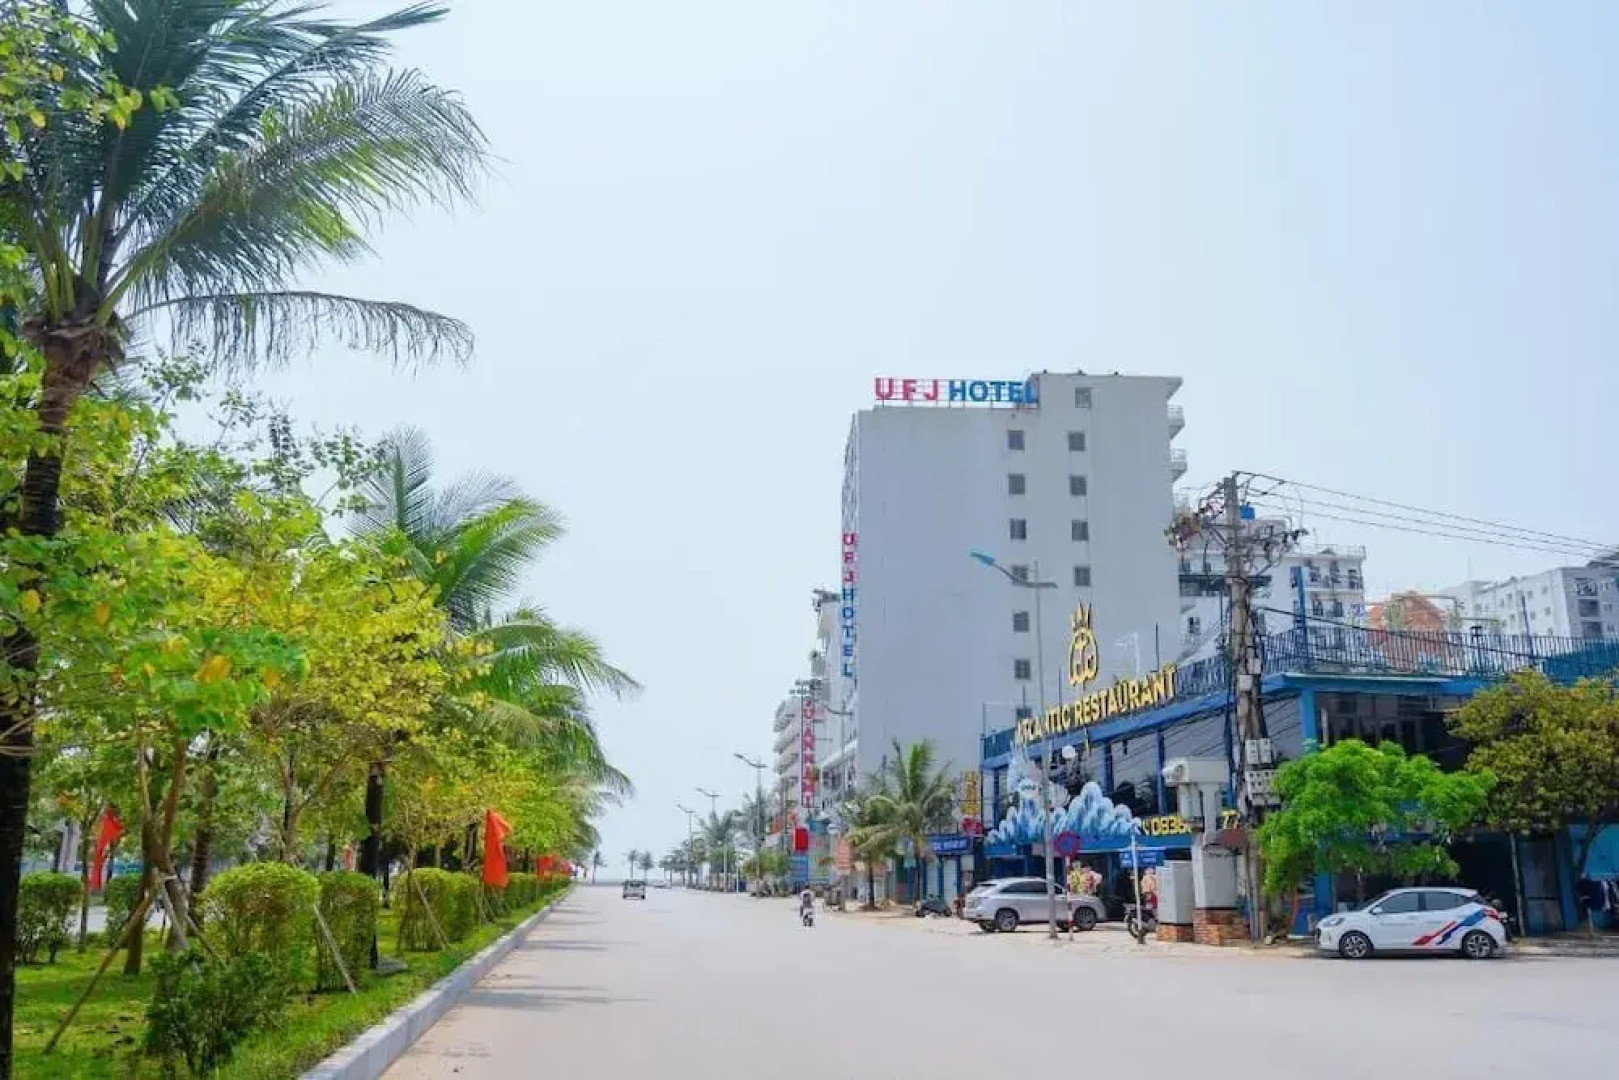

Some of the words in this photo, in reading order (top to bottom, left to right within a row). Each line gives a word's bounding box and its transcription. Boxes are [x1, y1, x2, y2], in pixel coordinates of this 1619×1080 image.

[874, 377, 938, 401] UFJ
[948, 379, 1039, 403] HOTEL
[842, 588, 855, 677] HOTEL
[1074, 662, 1177, 726] RESTAURANT
